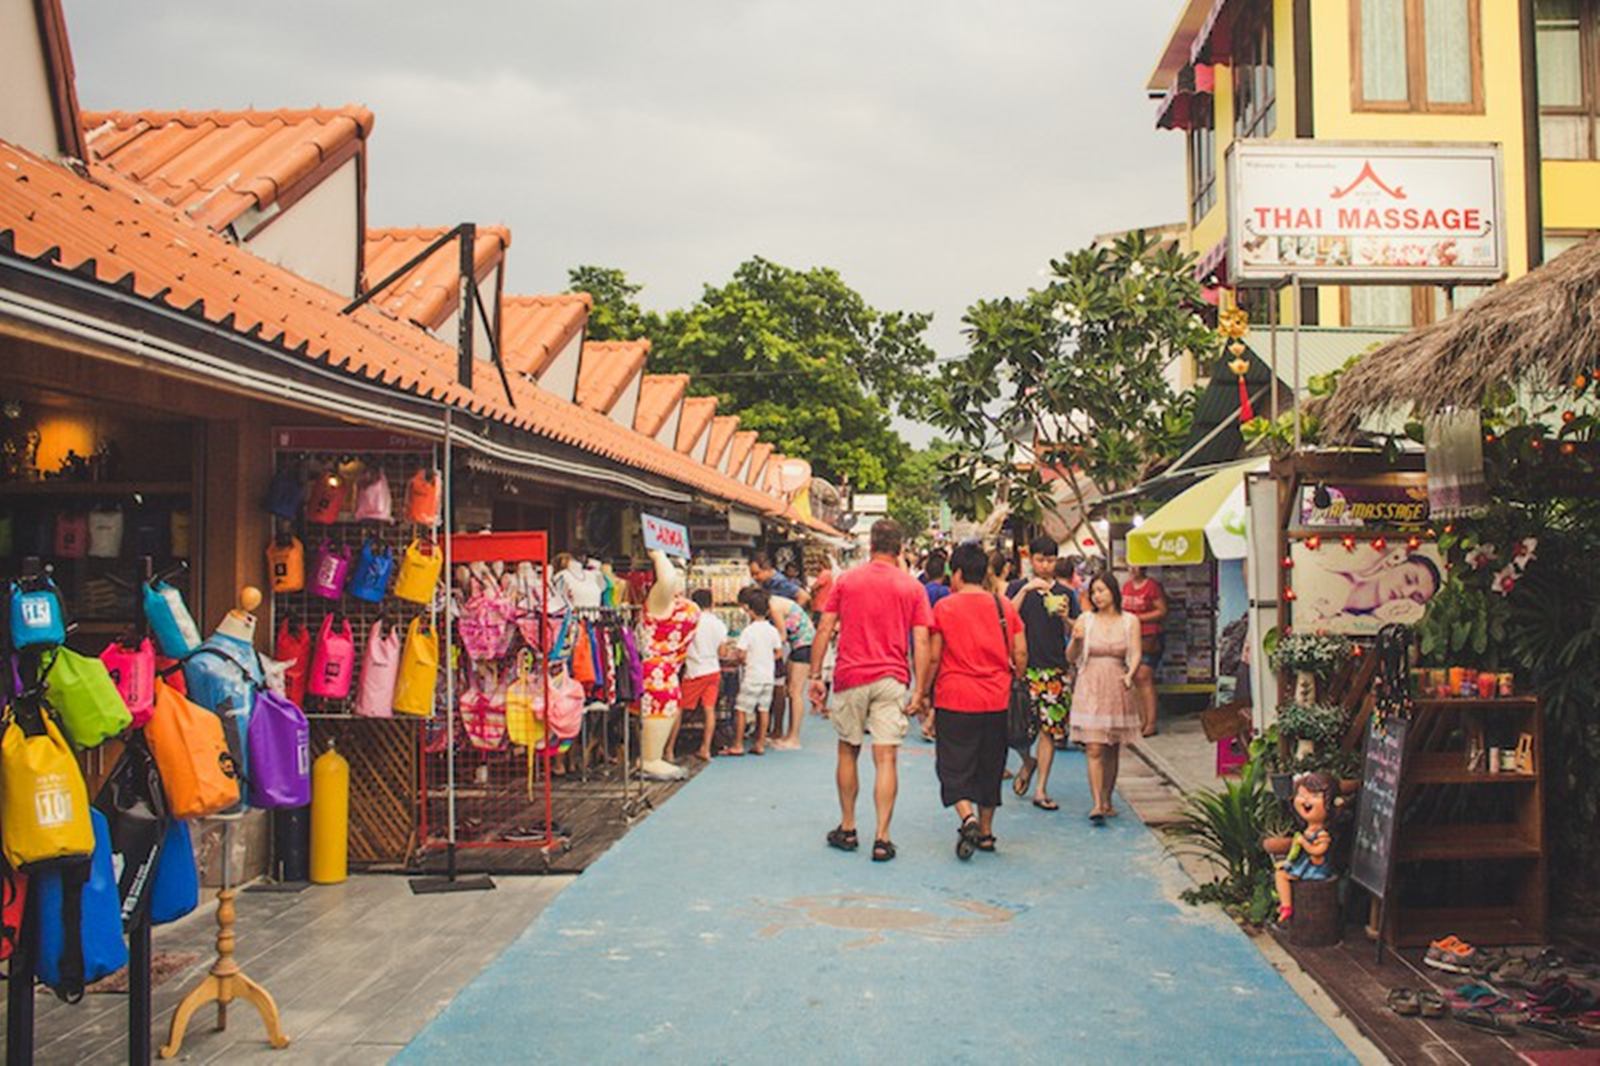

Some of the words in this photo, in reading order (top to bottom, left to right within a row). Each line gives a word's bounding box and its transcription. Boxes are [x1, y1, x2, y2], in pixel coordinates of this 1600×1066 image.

[1254, 207, 1322, 229] THAI
[1338, 208, 1481, 230] MASSAGE
[1351, 502, 1424, 520] MASSAGE
